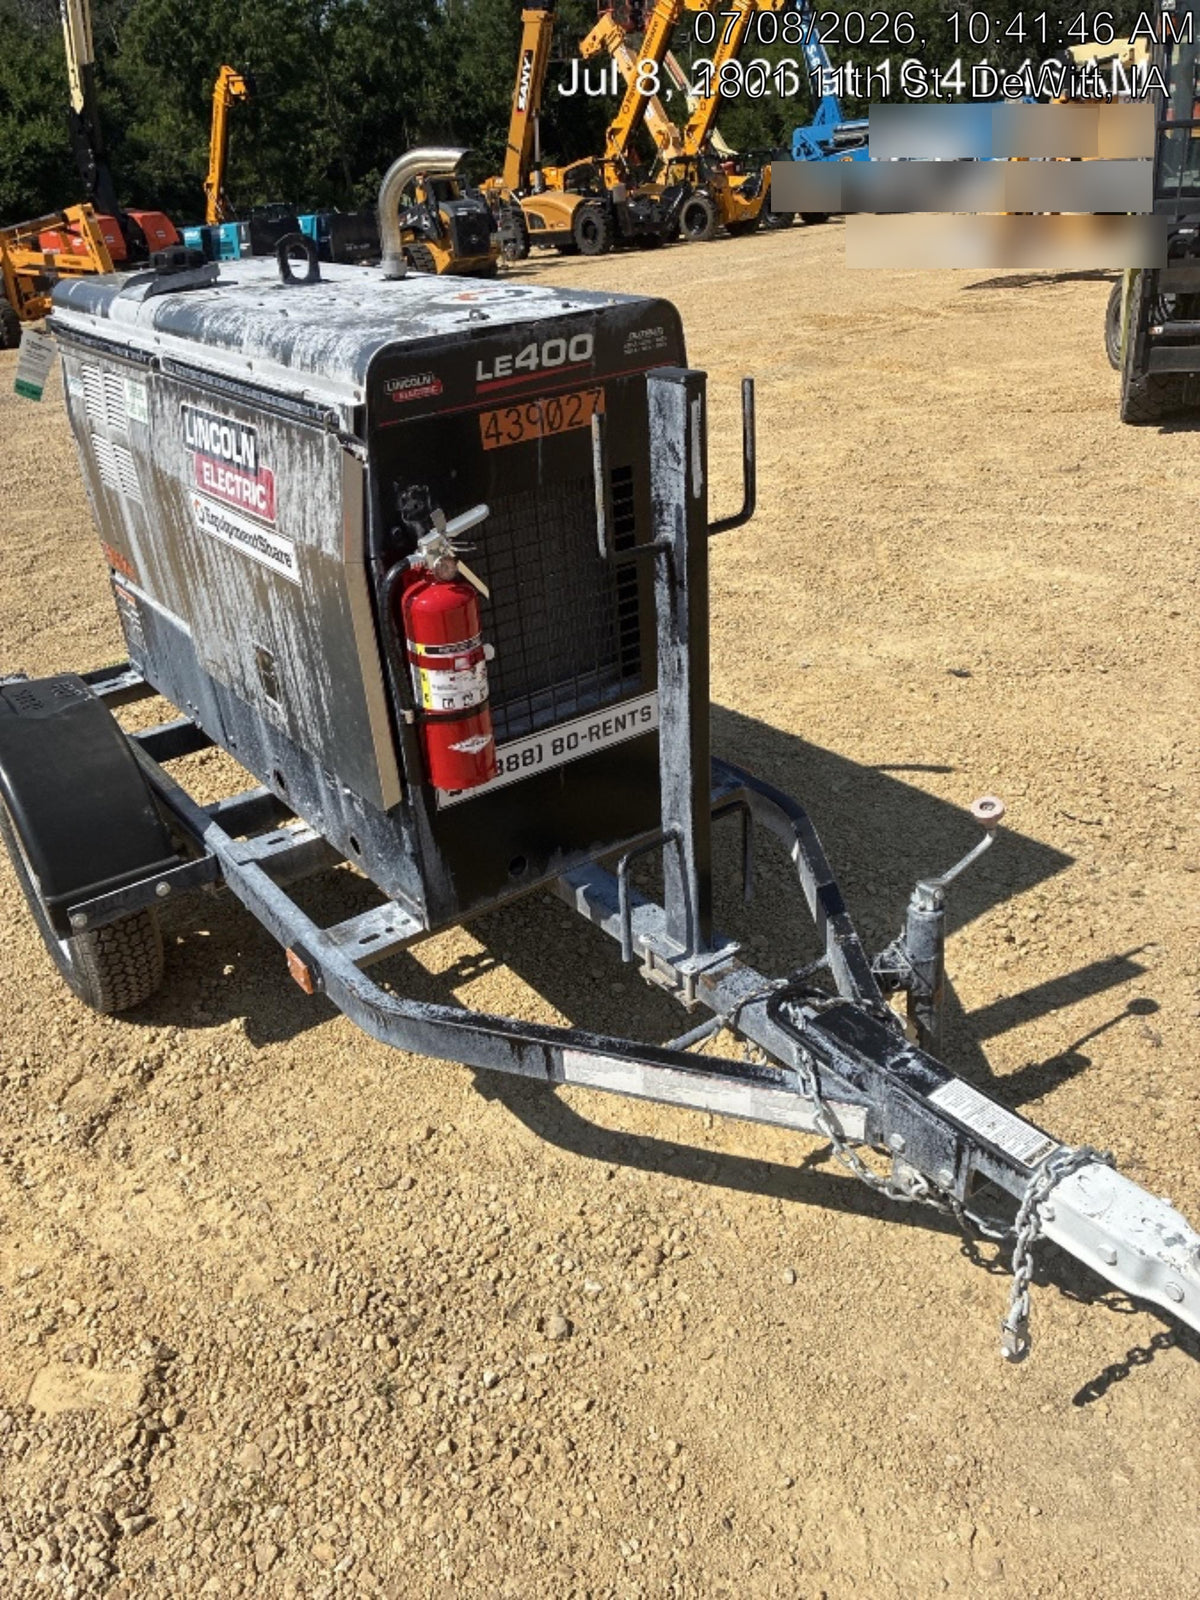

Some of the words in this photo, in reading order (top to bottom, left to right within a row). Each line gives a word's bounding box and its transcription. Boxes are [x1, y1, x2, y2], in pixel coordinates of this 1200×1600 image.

[518, 55, 532, 111] SANY
[476, 333, 593, 381] LE400
[184, 411, 256, 469] LINCOLN
[484, 388, 601, 445] 439027
[201, 461, 267, 511] ELECTRIC
[551, 705, 653, 757] 80-RENTS
